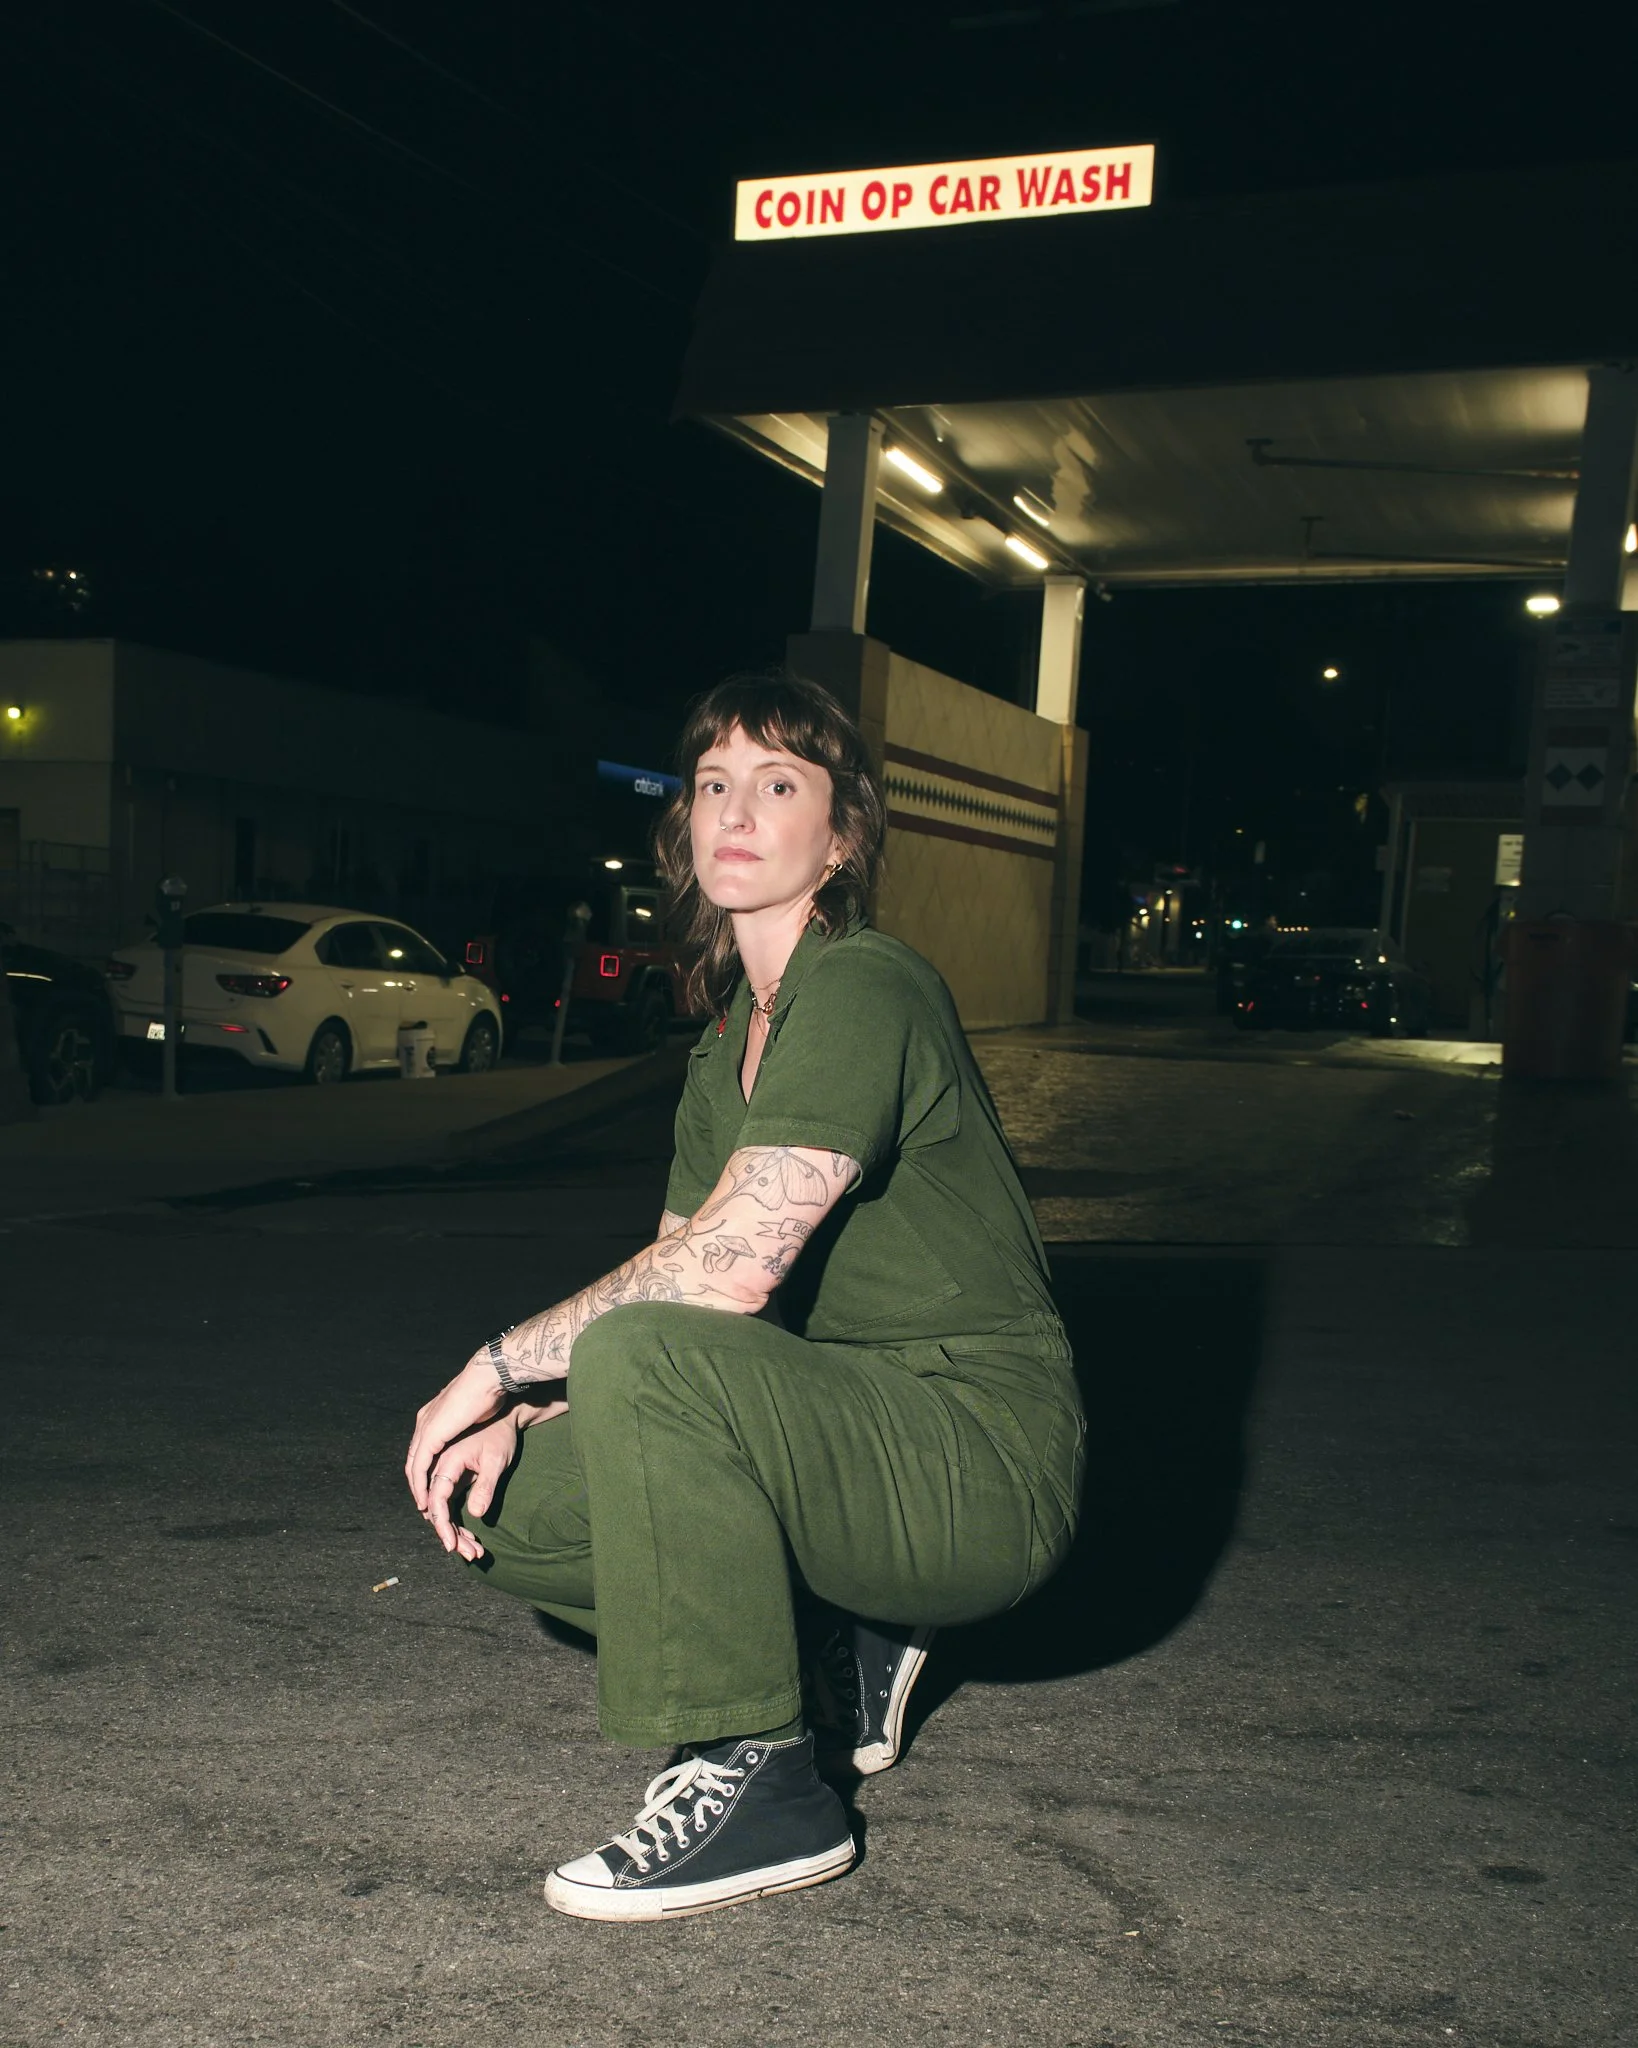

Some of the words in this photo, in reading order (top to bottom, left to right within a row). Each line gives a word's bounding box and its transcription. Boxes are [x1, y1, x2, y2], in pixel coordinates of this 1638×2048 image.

[754, 188, 845, 229] COIN
[861, 180, 913, 221] OP
[928, 174, 1001, 216] CAR
[1016, 162, 1132, 209] WASH
